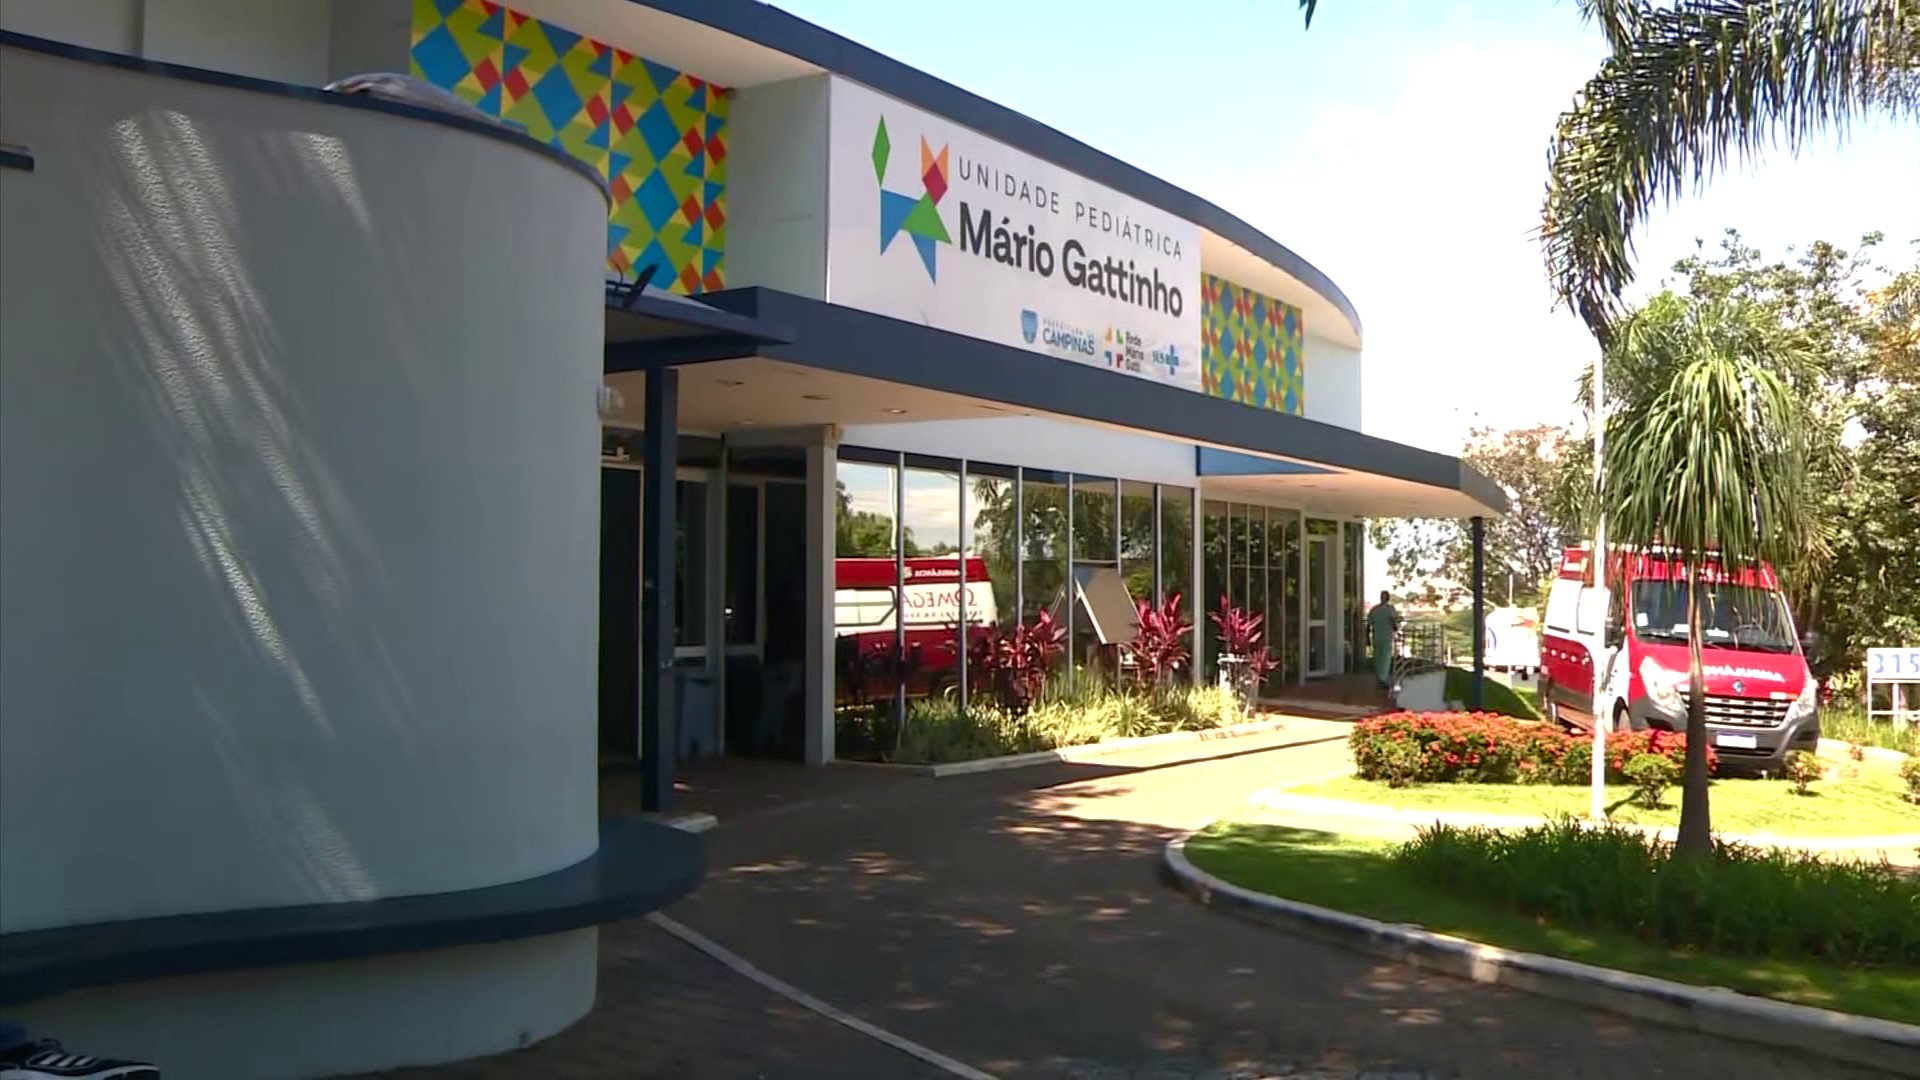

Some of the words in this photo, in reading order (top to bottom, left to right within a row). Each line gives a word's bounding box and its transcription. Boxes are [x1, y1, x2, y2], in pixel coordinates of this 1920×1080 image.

[959, 156, 1059, 214] UNIDADE
[1075, 202, 1182, 260] PEDIÁTRICA
[959, 201, 1054, 278] Mário
[1062, 239, 1183, 318] Gattinho
[1042, 328, 1095, 356] CAMPINAS
[1874, 653, 1920, 674] 315
